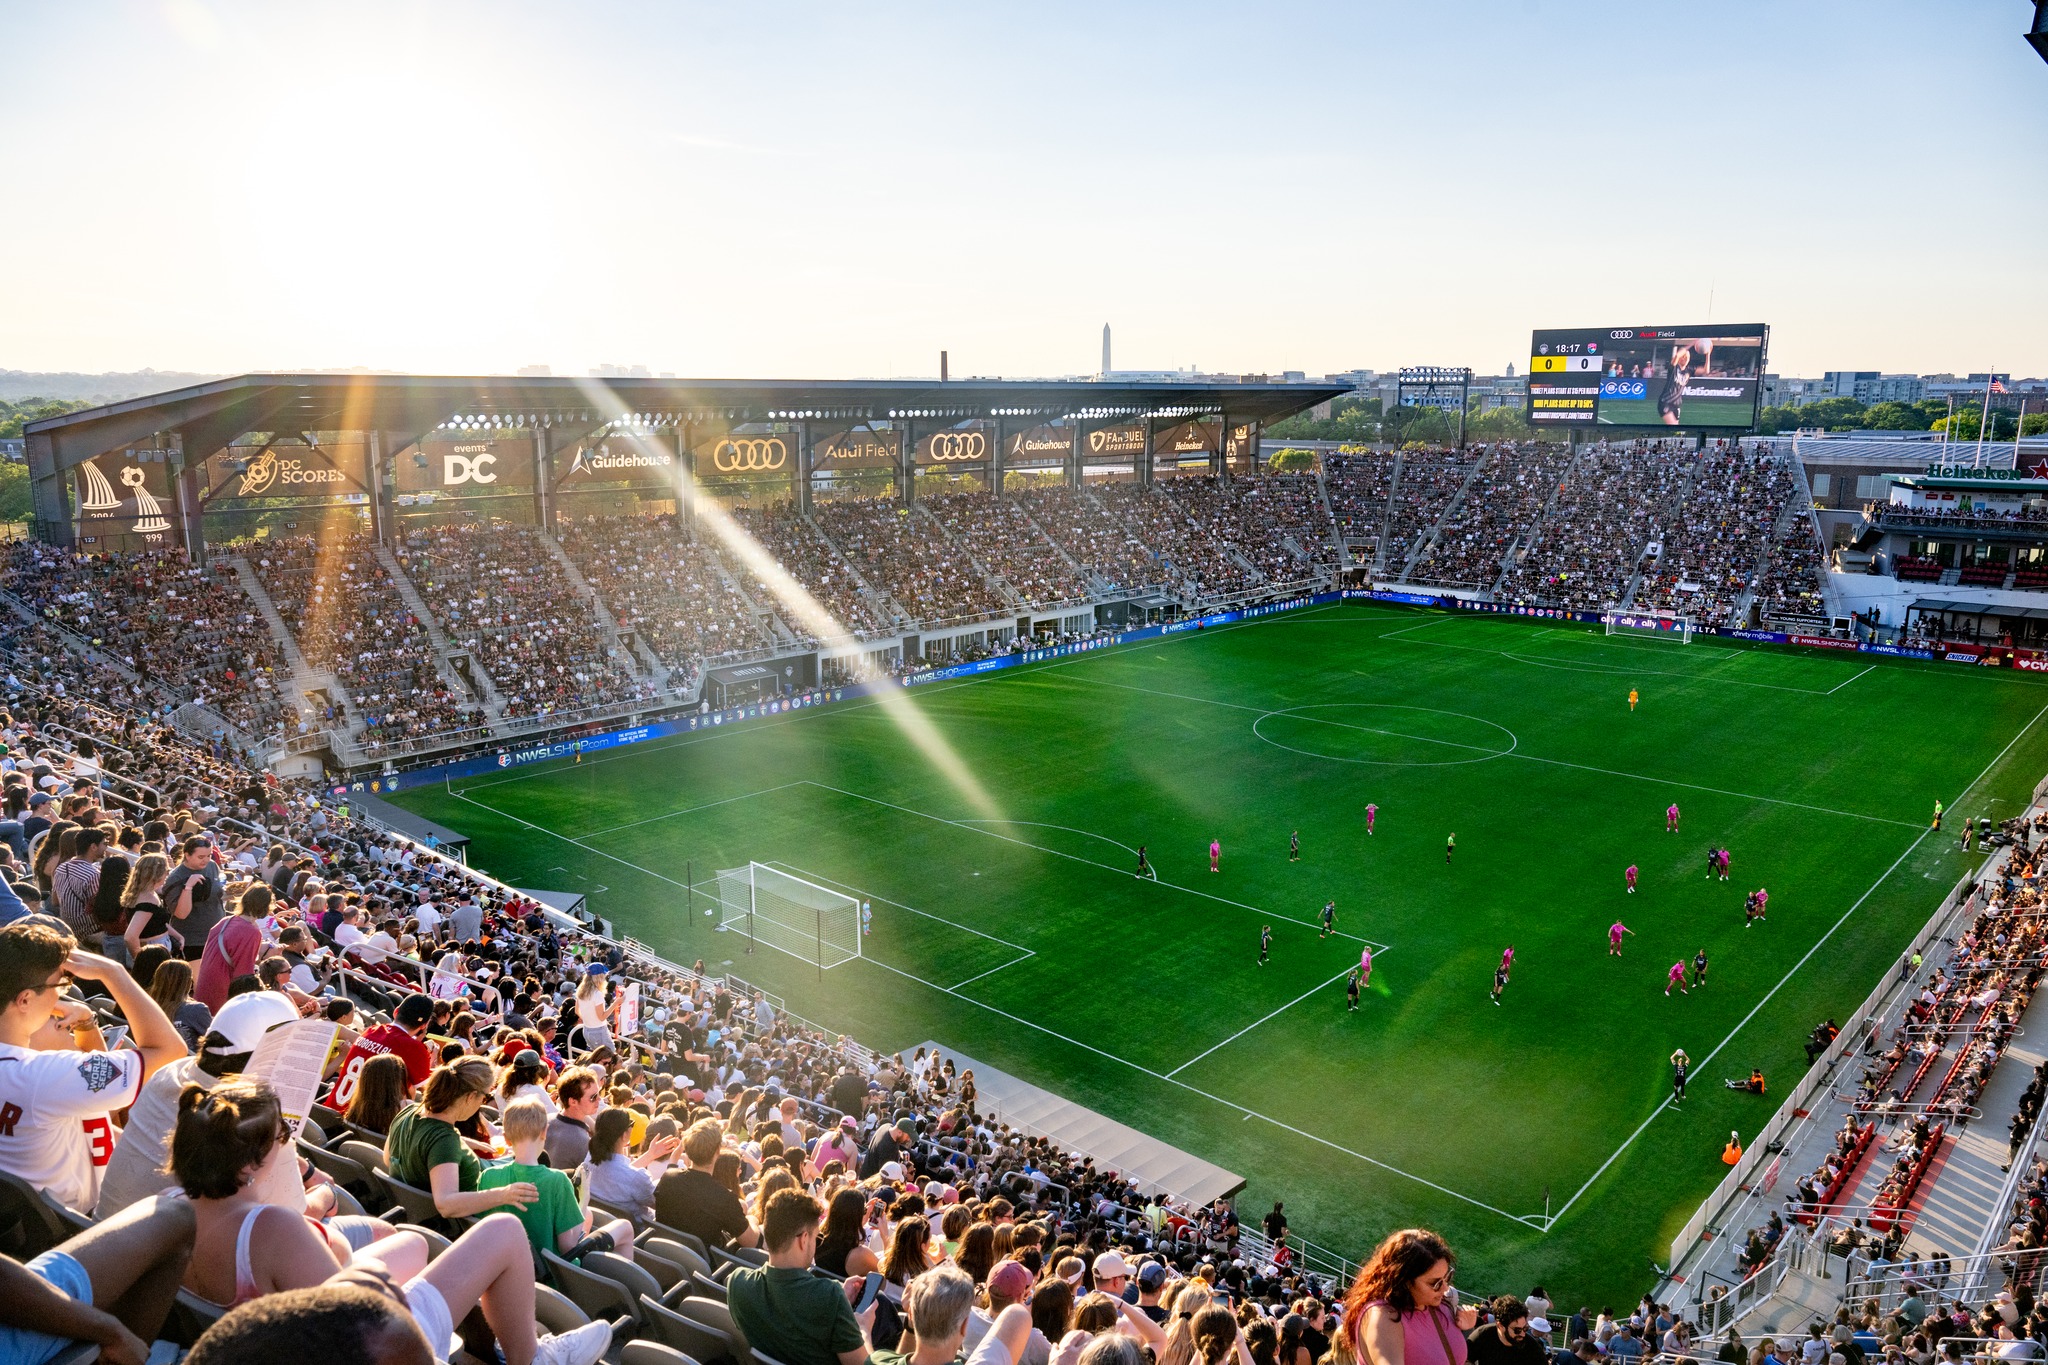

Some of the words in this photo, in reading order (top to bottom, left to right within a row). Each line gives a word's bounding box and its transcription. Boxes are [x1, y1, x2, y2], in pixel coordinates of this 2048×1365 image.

[1555, 344, 1581, 353] 18:17
[1545, 359, 1553, 370] 0
[1581, 358, 1589, 369] 0
[1682, 387, 1742, 397] Nationwide
[454, 444, 486, 452] events
[1025, 439, 1071, 450] Guidehouse
[1105, 442, 1144, 451] SPORTSBOOK
[825, 444, 862, 458] Audi
[866, 443, 897, 457] Field
[281, 459, 301, 470] DC
[591, 454, 671, 469] Guidehouse
[443, 453, 497, 485] DC
[1927, 463, 2021, 480] Heineken
[281, 469, 346, 484] SCORES
[142, 533, 163, 542] 999
[1621, 617, 1637, 627] ally
[1641, 620, 1657, 629] ally
[1685, 625, 1717, 635] DELTA
[1732, 630, 1751, 638] xfinity
[1801, 638, 1856, 649] NWSLSHOP.COM
[1948, 653, 1977, 662] SNICKERS
[2030, 661, 2048, 670] CV
[90, 1055, 101, 1089] WORLD
[97, 1057, 108, 1089] SERIES
[335, 1055, 365, 1107] 8
[82, 1117, 114, 1167] 3
